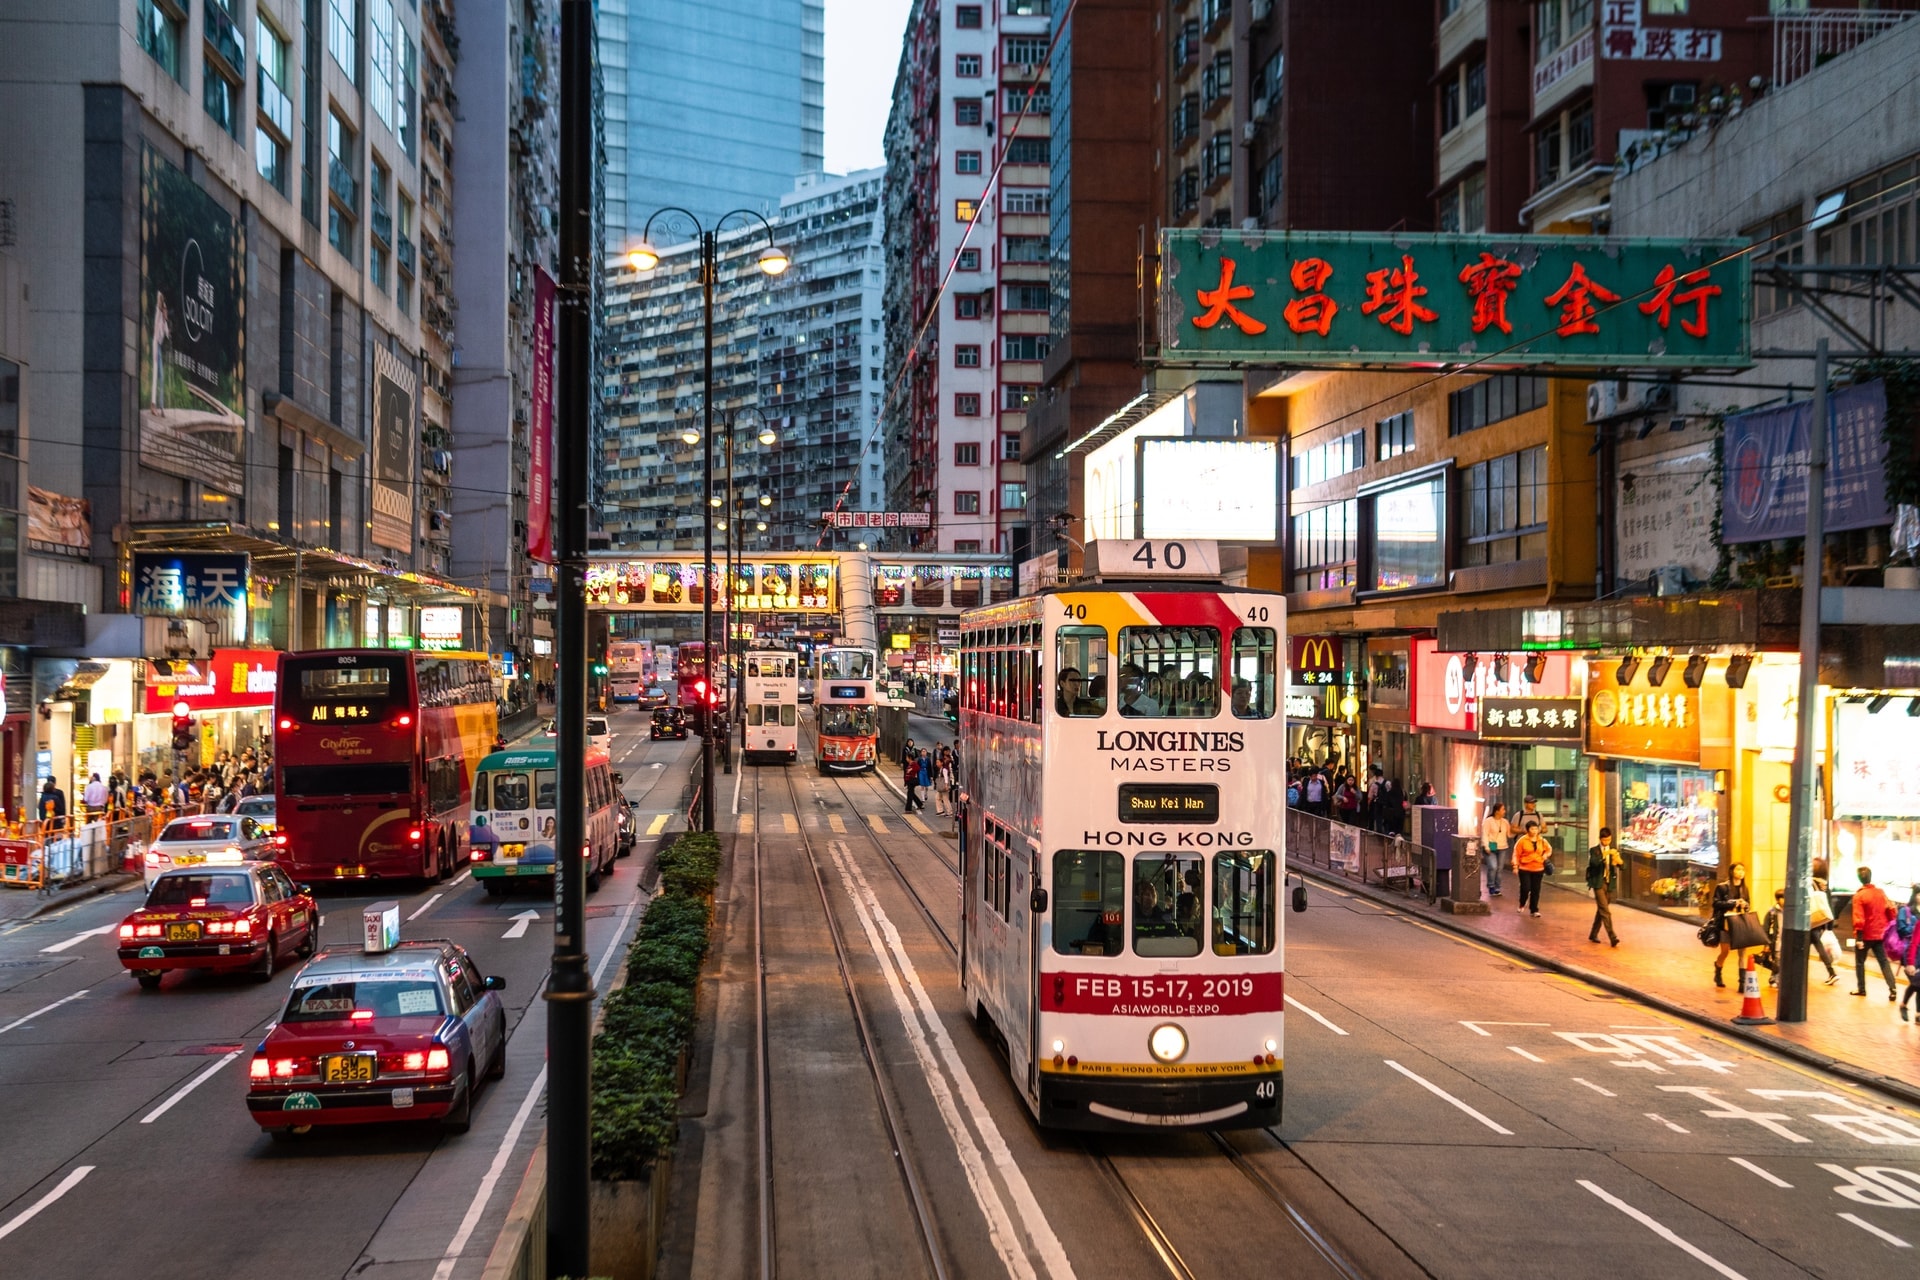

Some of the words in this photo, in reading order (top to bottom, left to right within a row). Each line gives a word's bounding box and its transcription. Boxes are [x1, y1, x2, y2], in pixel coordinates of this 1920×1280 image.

[1192, 252, 1723, 338] 大昌珠寶金行
[1132, 541, 1186, 569] 40
[1063, 604, 1087, 620] 40
[1247, 606, 1269, 622] 40
[338, 656, 357, 664] 8054
[1318, 672, 1333, 683] 24
[1097, 730, 1244, 752] LONGINES
[1111, 757, 1231, 772] MASTERS
[1131, 797, 1156, 809] Shau
[1161, 797, 1179, 809] Kei
[1184, 797, 1204, 809] Wan
[1084, 831, 1168, 846] HONG
[1178, 831, 1254, 846] KONG
[363, 915, 381, 924] TAXI
[1103, 913, 1121, 922] 101
[367, 924, 378, 941] 的士
[1076, 978, 1122, 997] FEB
[1131, 978, 1193, 1001] 15-17,
[1202, 978, 1254, 998] 2019
[305, 999, 350, 1011] TAXI
[1112, 1004, 1220, 1015] ASIAWORLD-EXPO
[340, 1058, 360, 1069] GM
[1081, 1064, 1112, 1073] PARIS
[1122, 1065, 1153, 1073] HONG
[1156, 1065, 1186, 1073] KONG
[1195, 1065, 1218, 1073] NEW
[1221, 1064, 1247, 1073] YORK
[331, 1067, 369, 1080] 2932
[1256, 1081, 1275, 1098] 40
